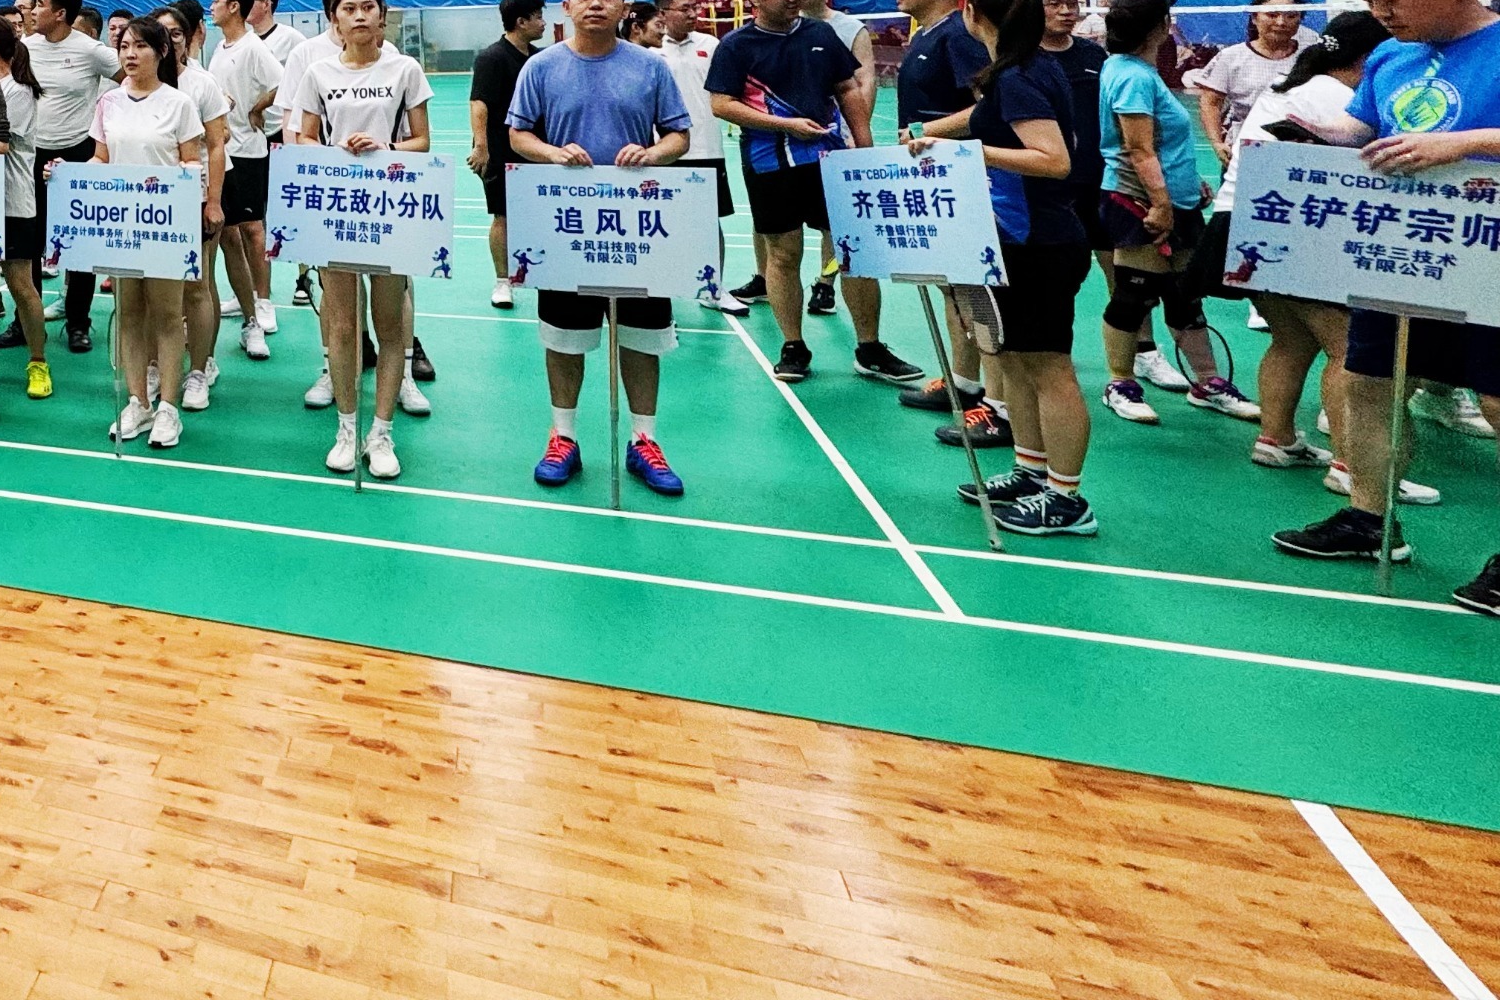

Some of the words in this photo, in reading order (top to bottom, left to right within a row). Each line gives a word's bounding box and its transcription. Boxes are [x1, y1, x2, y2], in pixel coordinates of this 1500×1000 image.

[351, 86, 393, 99] YONEX
[1286, 167, 1500, 205] 首届“CBD羽林争霸
[280, 182, 444, 221] 宇宙无敌小分队
[852, 187, 956, 219] 齐鲁银行
[69, 199, 129, 225] Super
[135, 203, 172, 226] idol
[554, 206, 670, 239] 追风队
[1251, 189, 1500, 252] 金铲铲宗师
[323, 217, 393, 235] 中建山东投资
[874, 224, 938, 237] 齐鲁银行股份
[105, 239, 142, 250] 山东分所
[334, 230, 381, 245] 有限公司
[570, 239, 651, 255] 金风科技股份
[887, 236, 931, 250] 有限公司
[584, 251, 638, 266] 有限公司
[1343, 240, 1458, 268] 新华三技术
[1353, 256, 1444, 281] 有限公司
